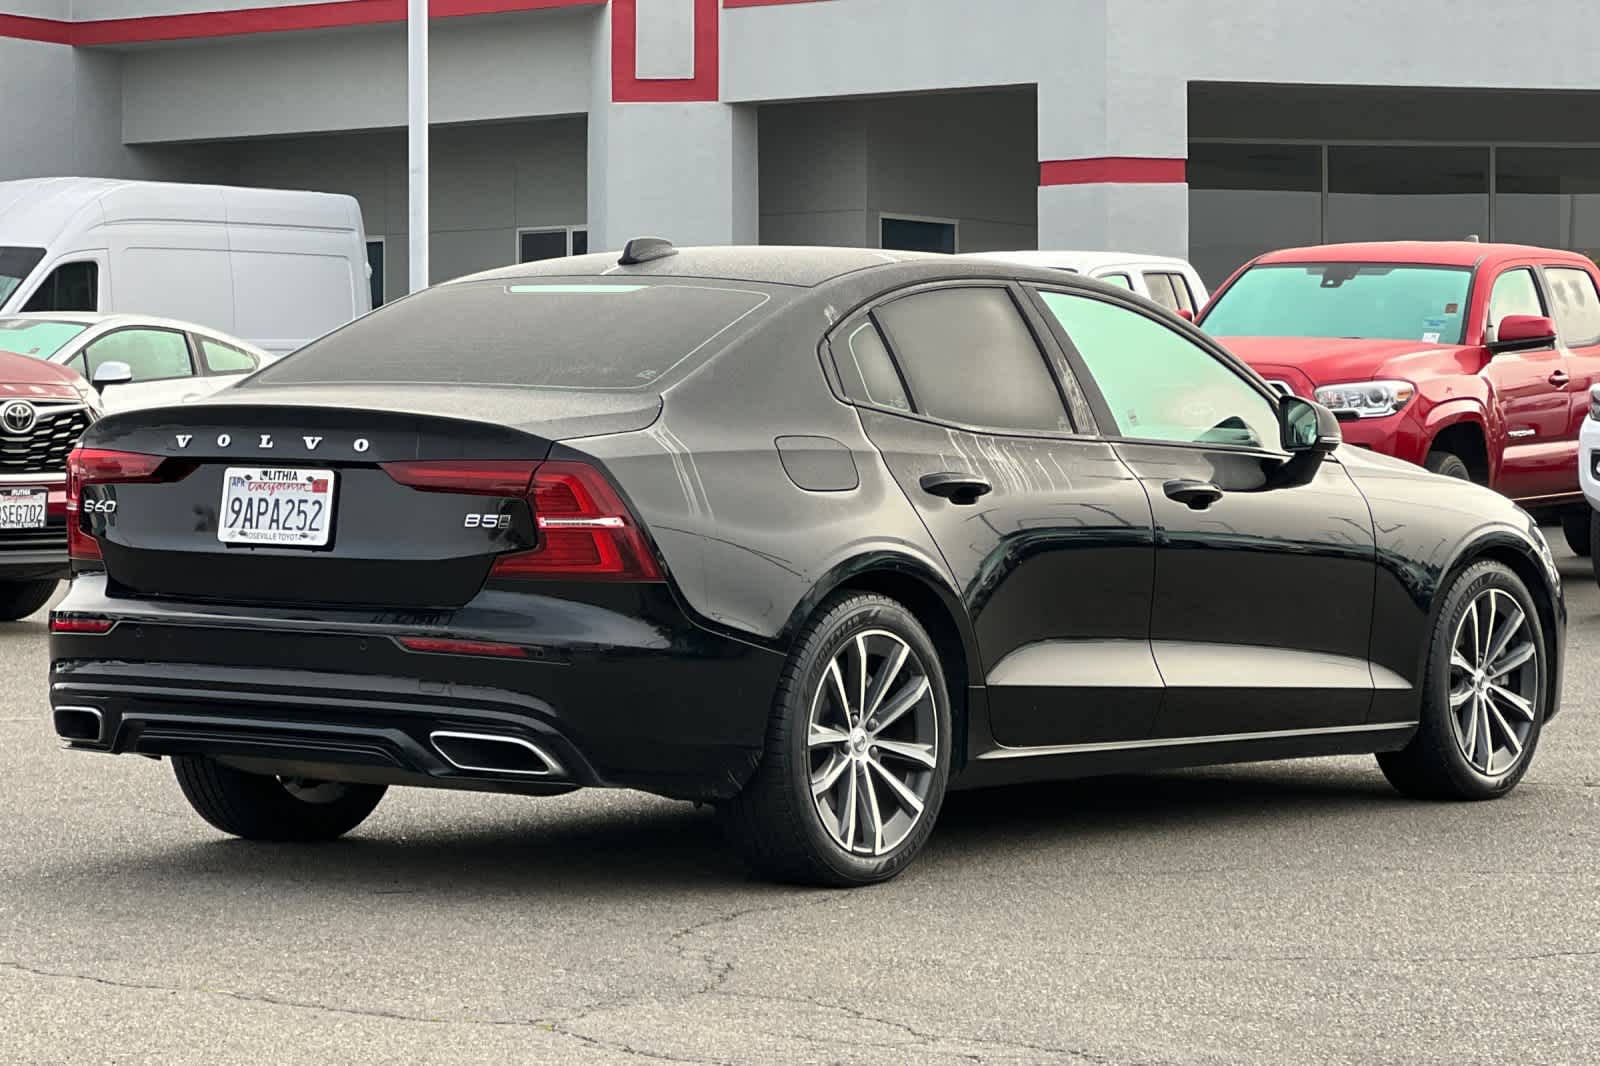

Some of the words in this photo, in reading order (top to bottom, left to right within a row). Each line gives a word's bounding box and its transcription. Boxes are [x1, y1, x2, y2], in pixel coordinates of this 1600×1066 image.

[175, 433, 369, 452] VOLVO
[268, 470, 298, 481] LITHIA
[0, 504, 43, 523] SEG702
[84, 499, 117, 512] S60
[228, 497, 323, 531] 9APA252
[464, 513, 499, 528] B5
